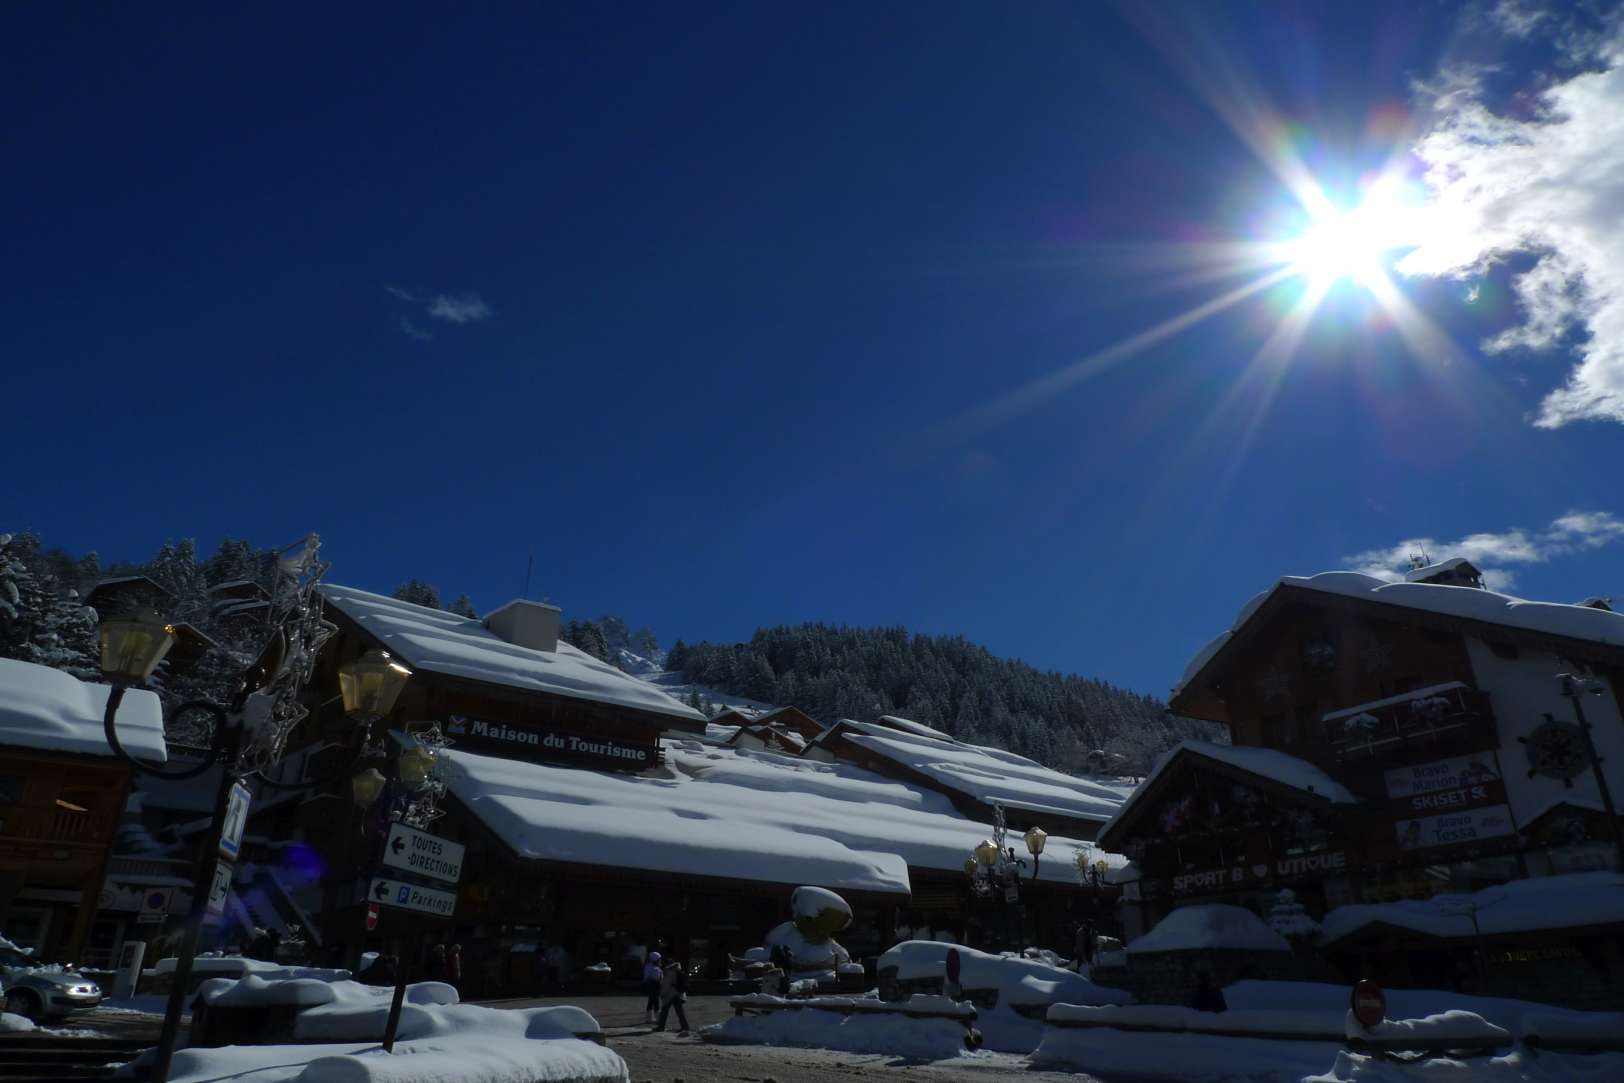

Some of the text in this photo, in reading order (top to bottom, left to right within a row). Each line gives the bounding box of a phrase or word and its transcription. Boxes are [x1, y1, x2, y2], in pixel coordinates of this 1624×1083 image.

[471, 720, 646, 761] Maison du Tourisme
[1412, 763, 1449, 778] Bravo
[1411, 790, 1467, 809] SKISET
[411, 835, 443, 855] TOUTES
[410, 853, 458, 877] DIRECTIONS
[1173, 869, 1226, 889] SPORT
[411, 891, 453, 913] Parkings
